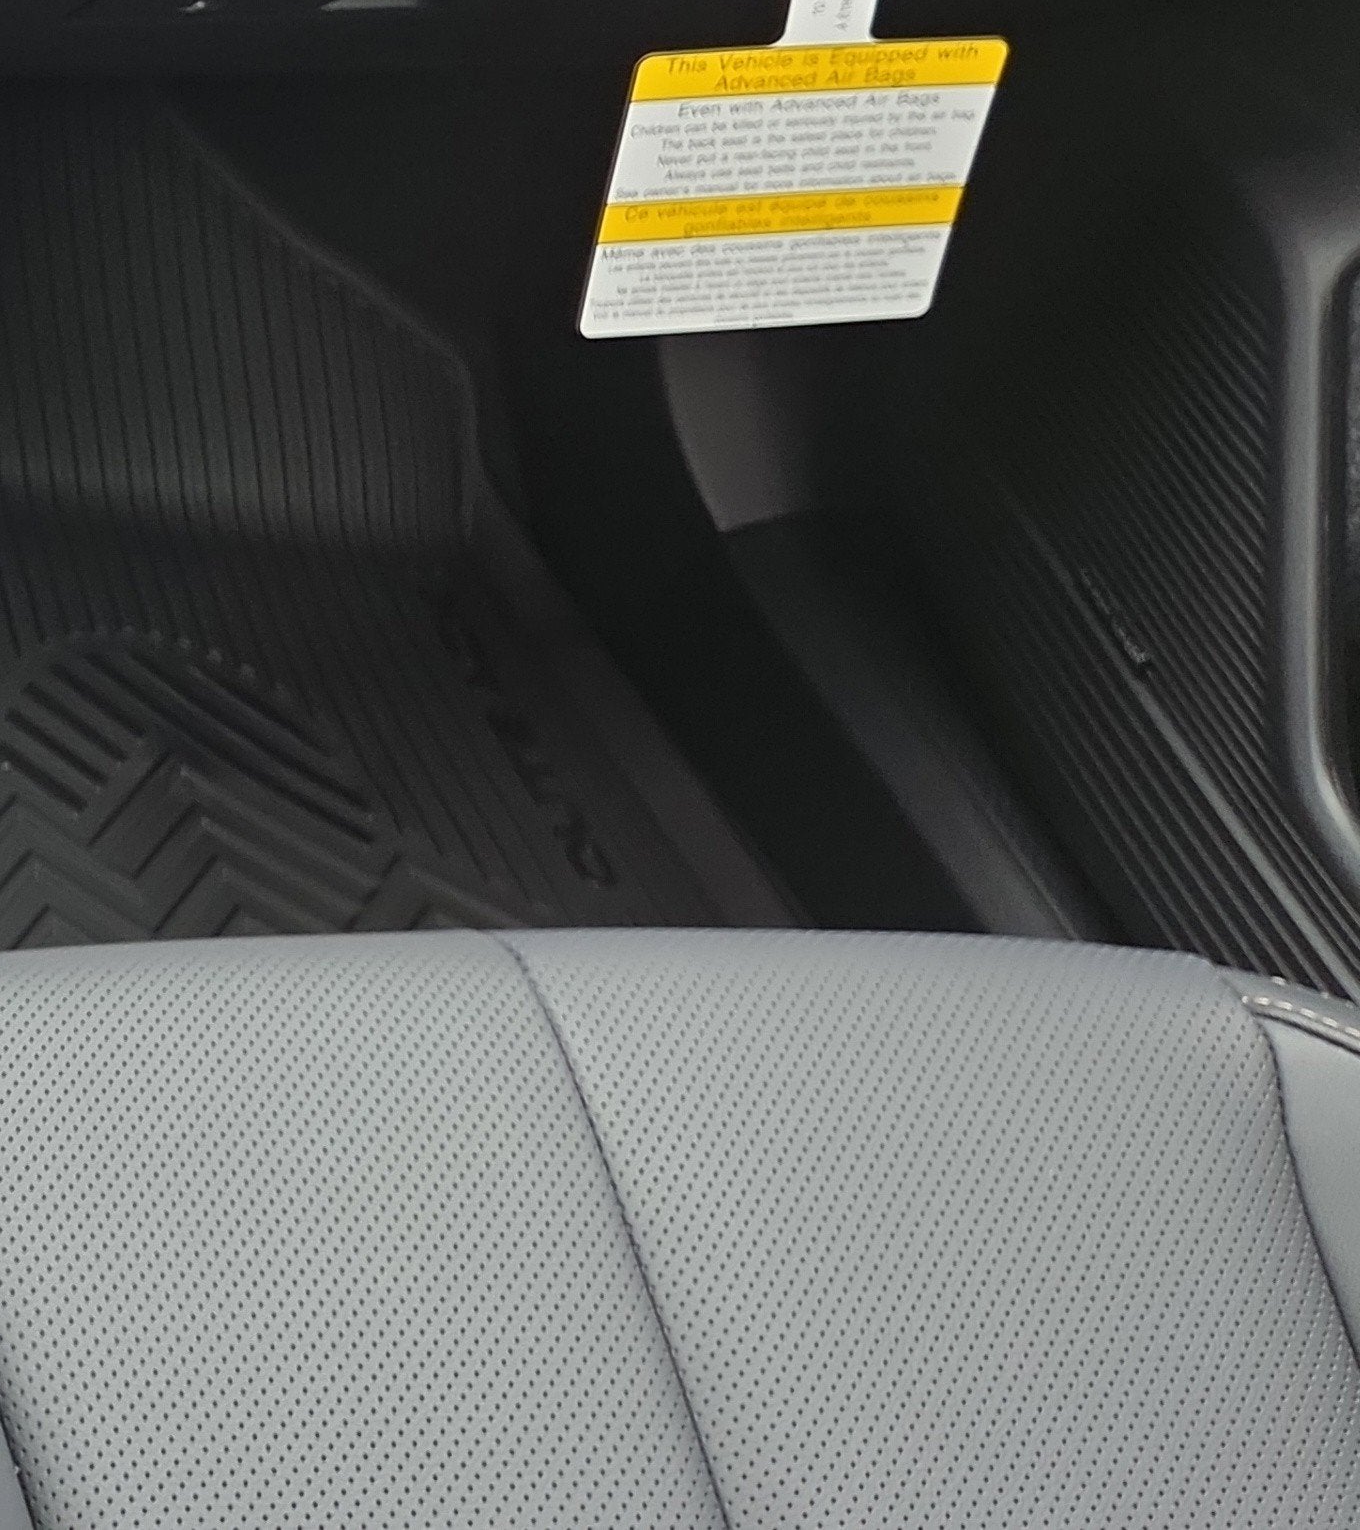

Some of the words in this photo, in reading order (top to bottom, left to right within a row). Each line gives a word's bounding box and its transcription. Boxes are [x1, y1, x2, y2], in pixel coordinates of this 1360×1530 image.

[666, 55, 707, 75] This
[719, 51, 793, 72] Vehicle
[829, 44, 927, 67] Equipped
[714, 69, 816, 92] Advanced
[826, 67, 852, 85] Air
[864, 65, 916, 87] Bags
